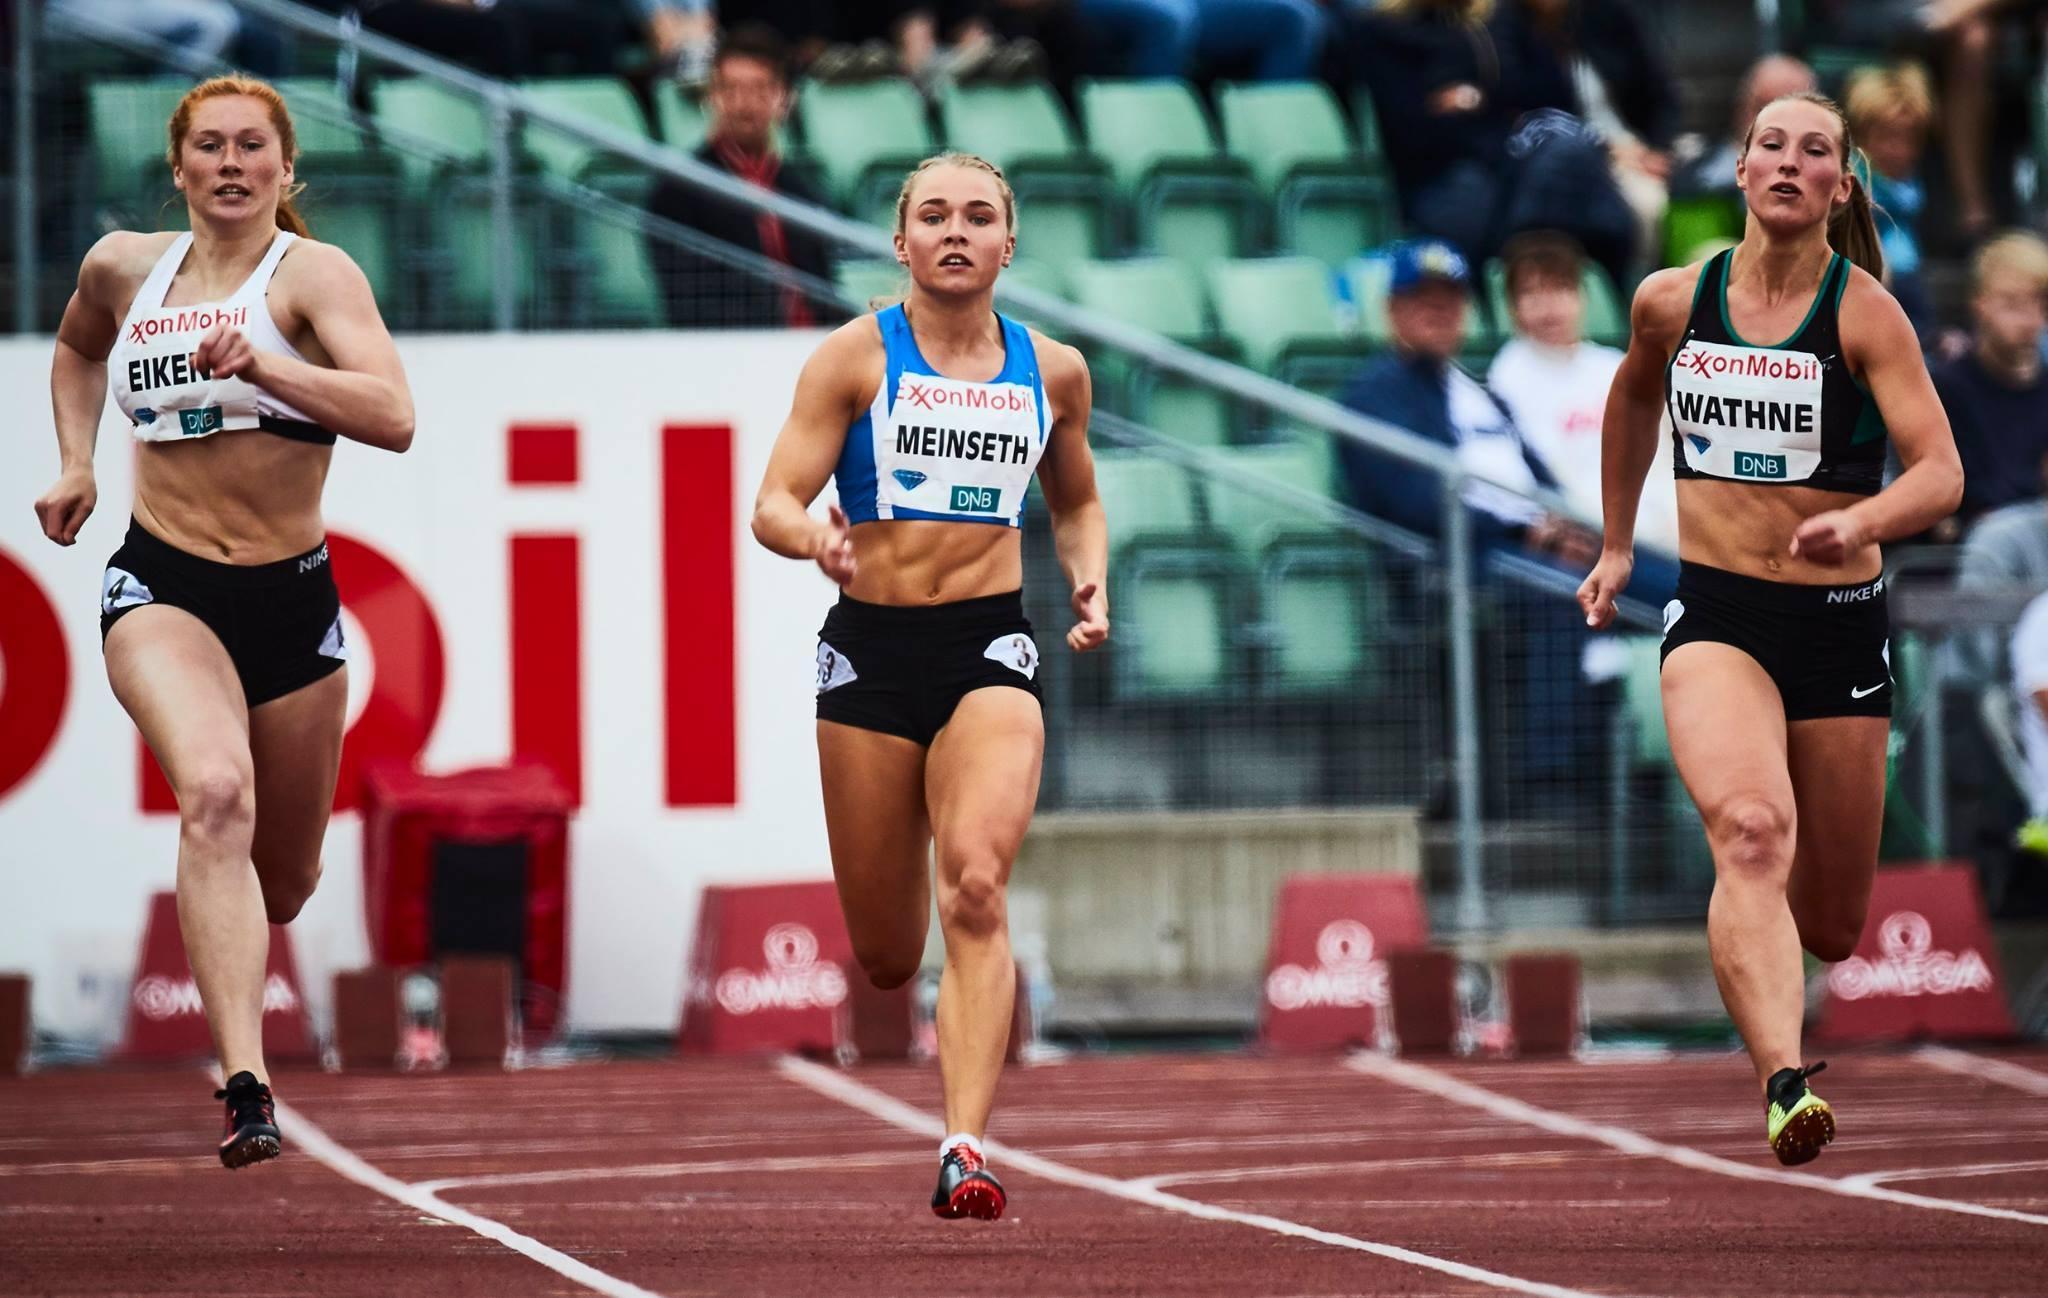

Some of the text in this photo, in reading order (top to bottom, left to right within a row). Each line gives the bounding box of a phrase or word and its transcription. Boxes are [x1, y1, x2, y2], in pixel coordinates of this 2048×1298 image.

[187, 408, 216, 435] DNB
[1676, 390, 1814, 433] WATHNE
[895, 424, 1029, 465] MEINSETH
[1742, 454, 1779, 477] DNB
[957, 487, 992, 511] DNB
[298, 541, 329, 574] NIKE
[107, 575, 129, 606] 4
[1827, 586, 1871, 604] NIKE
[1012, 637, 1031, 668] 3
